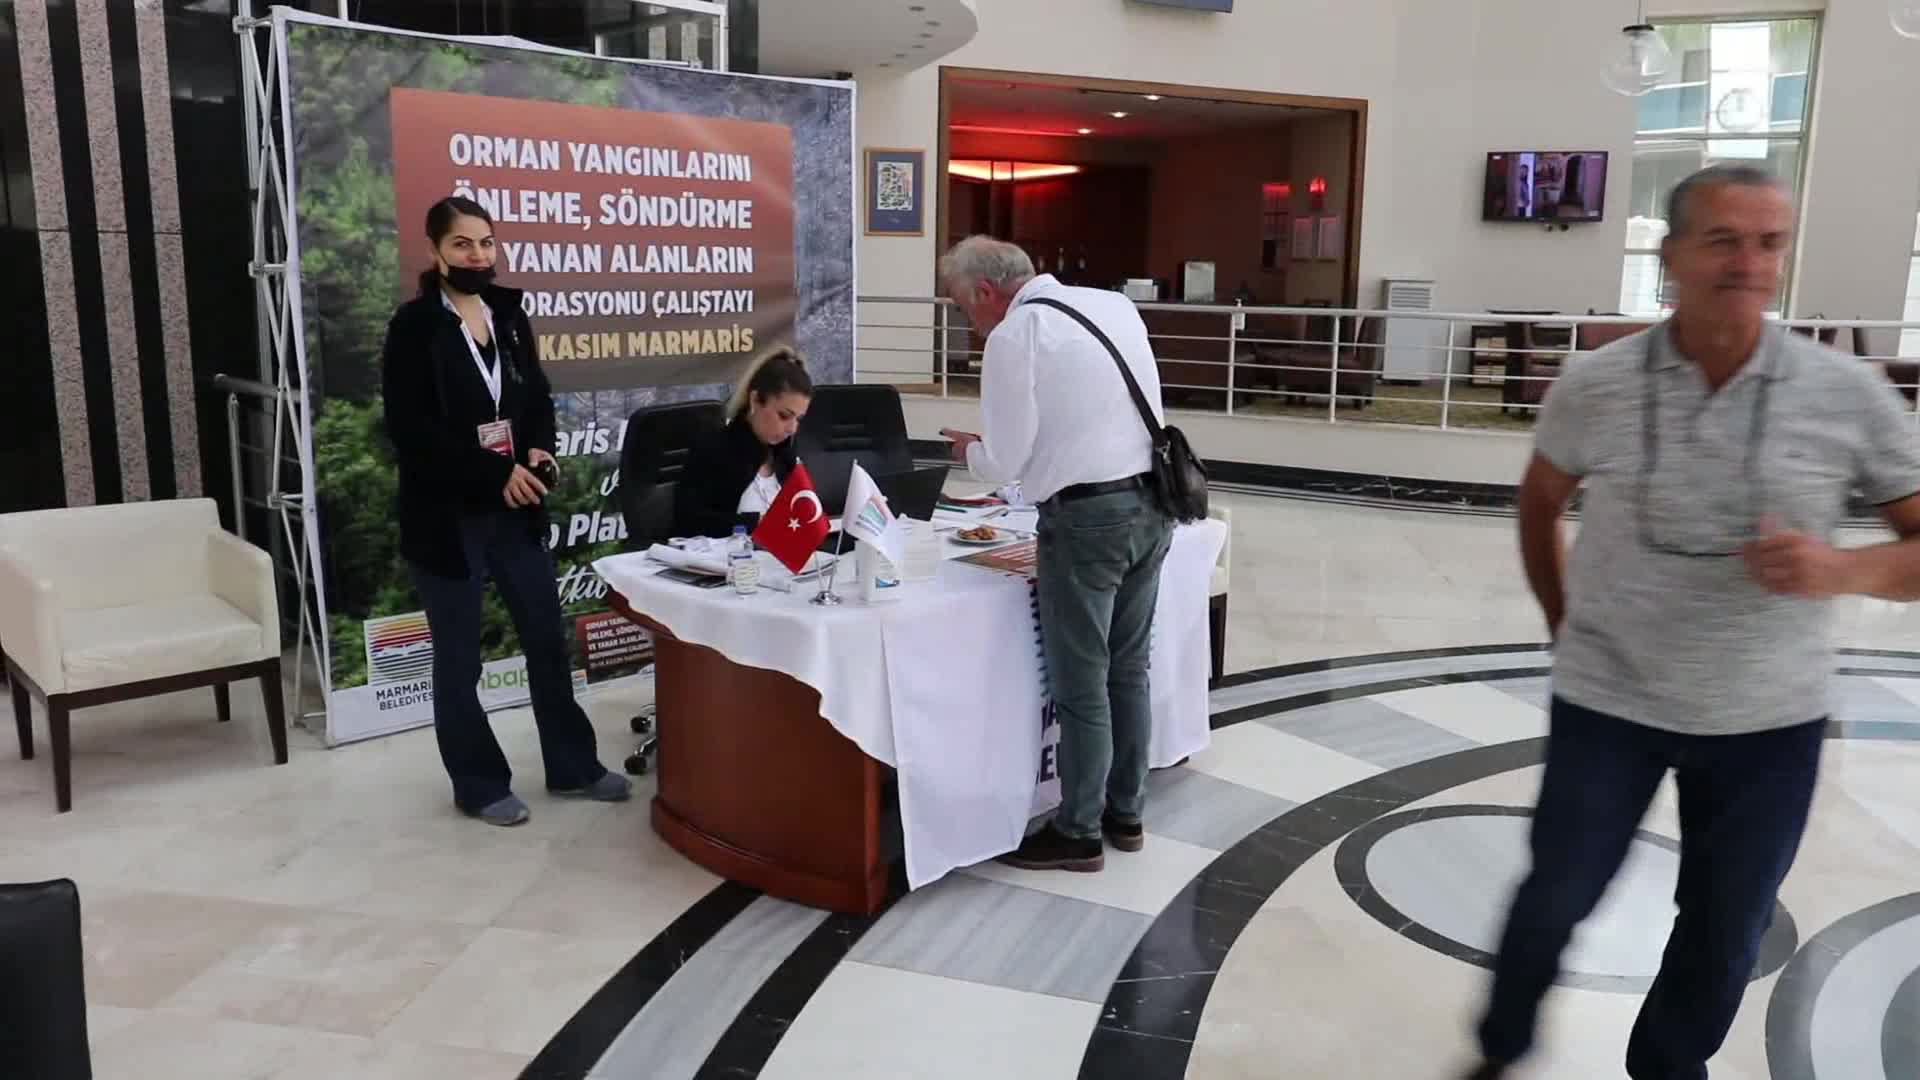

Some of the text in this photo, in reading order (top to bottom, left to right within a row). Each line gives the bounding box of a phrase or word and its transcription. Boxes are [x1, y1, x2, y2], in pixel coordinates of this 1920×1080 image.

[449, 133, 752, 182] ORMAN YANGINLARINI
[599, 188, 753, 229] SÖNDÜRME
[501, 243, 753, 273] YANAN ALANLARIN
[521, 290, 753, 318] ORASYONU ÇALIŞTAYI
[538, 324, 753, 361] KASIM MARMARİS
